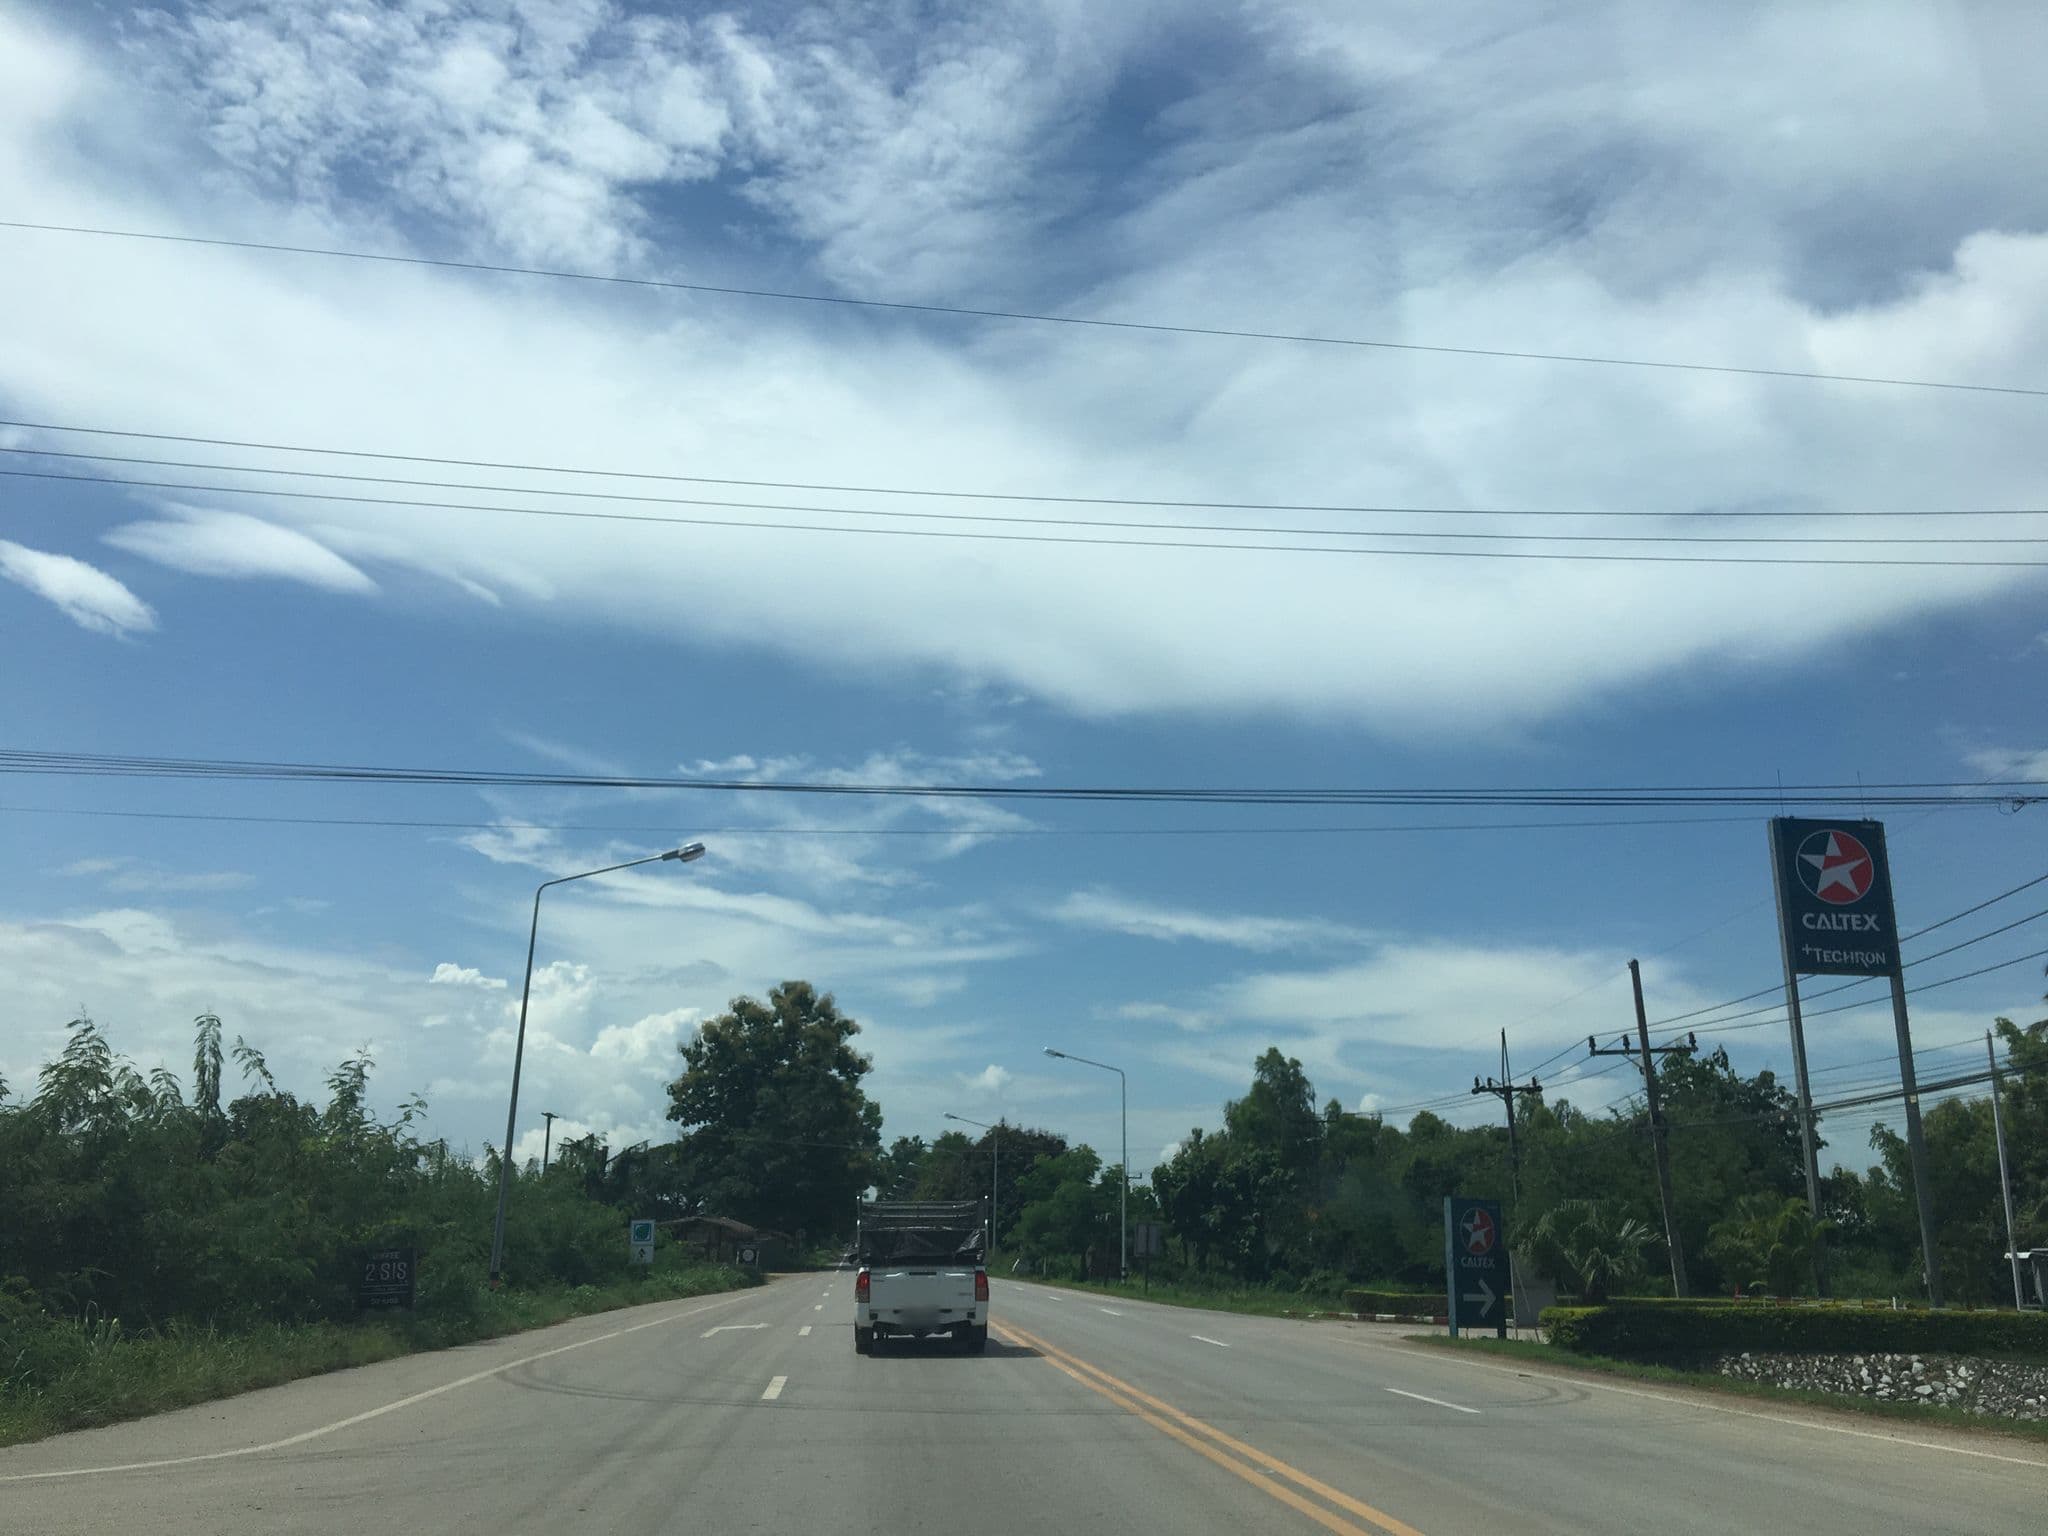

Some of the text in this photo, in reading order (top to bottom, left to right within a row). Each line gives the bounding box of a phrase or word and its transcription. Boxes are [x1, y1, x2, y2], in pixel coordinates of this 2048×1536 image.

[1801, 912, 1881, 932] CALTEX
[366, 1262, 407, 1281] 2 SIS
[1460, 1256, 1496, 1269] CALTEX
